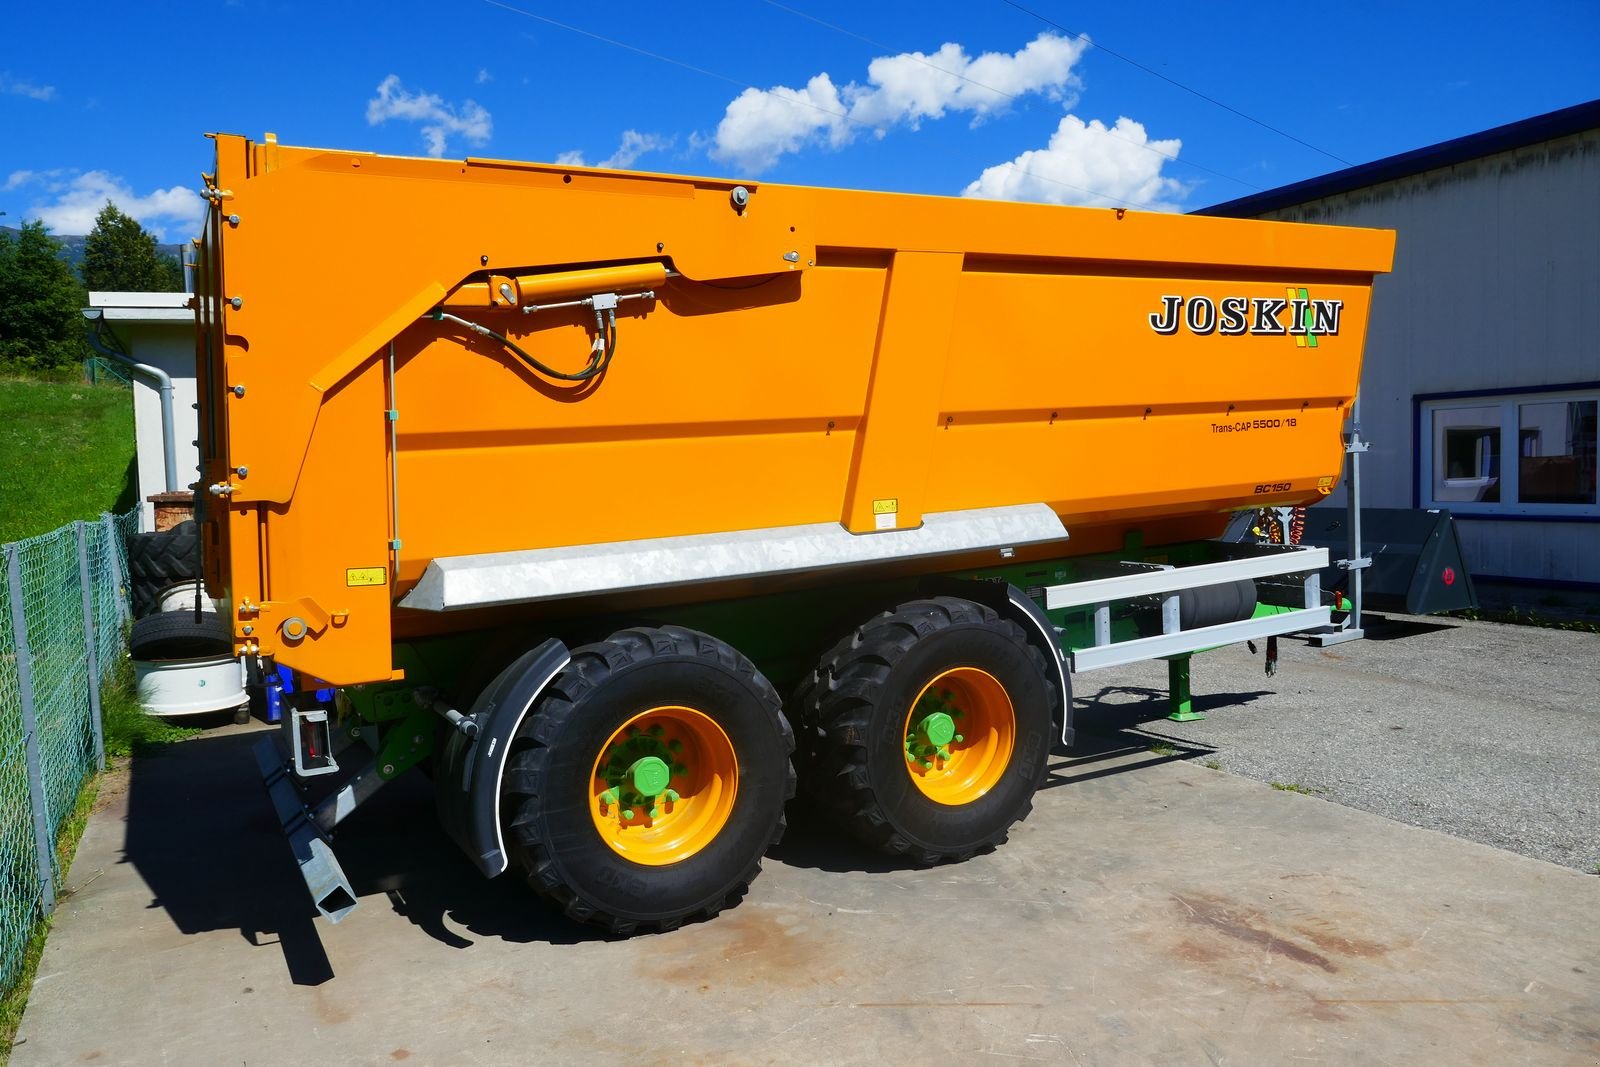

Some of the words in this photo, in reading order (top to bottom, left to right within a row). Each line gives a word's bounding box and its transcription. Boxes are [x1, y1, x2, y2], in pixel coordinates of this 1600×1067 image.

[1150, 295, 1343, 336] JOSKIN
[1211, 422, 1251, 433] Trans-CAP
[1254, 483, 1292, 494] BC150
